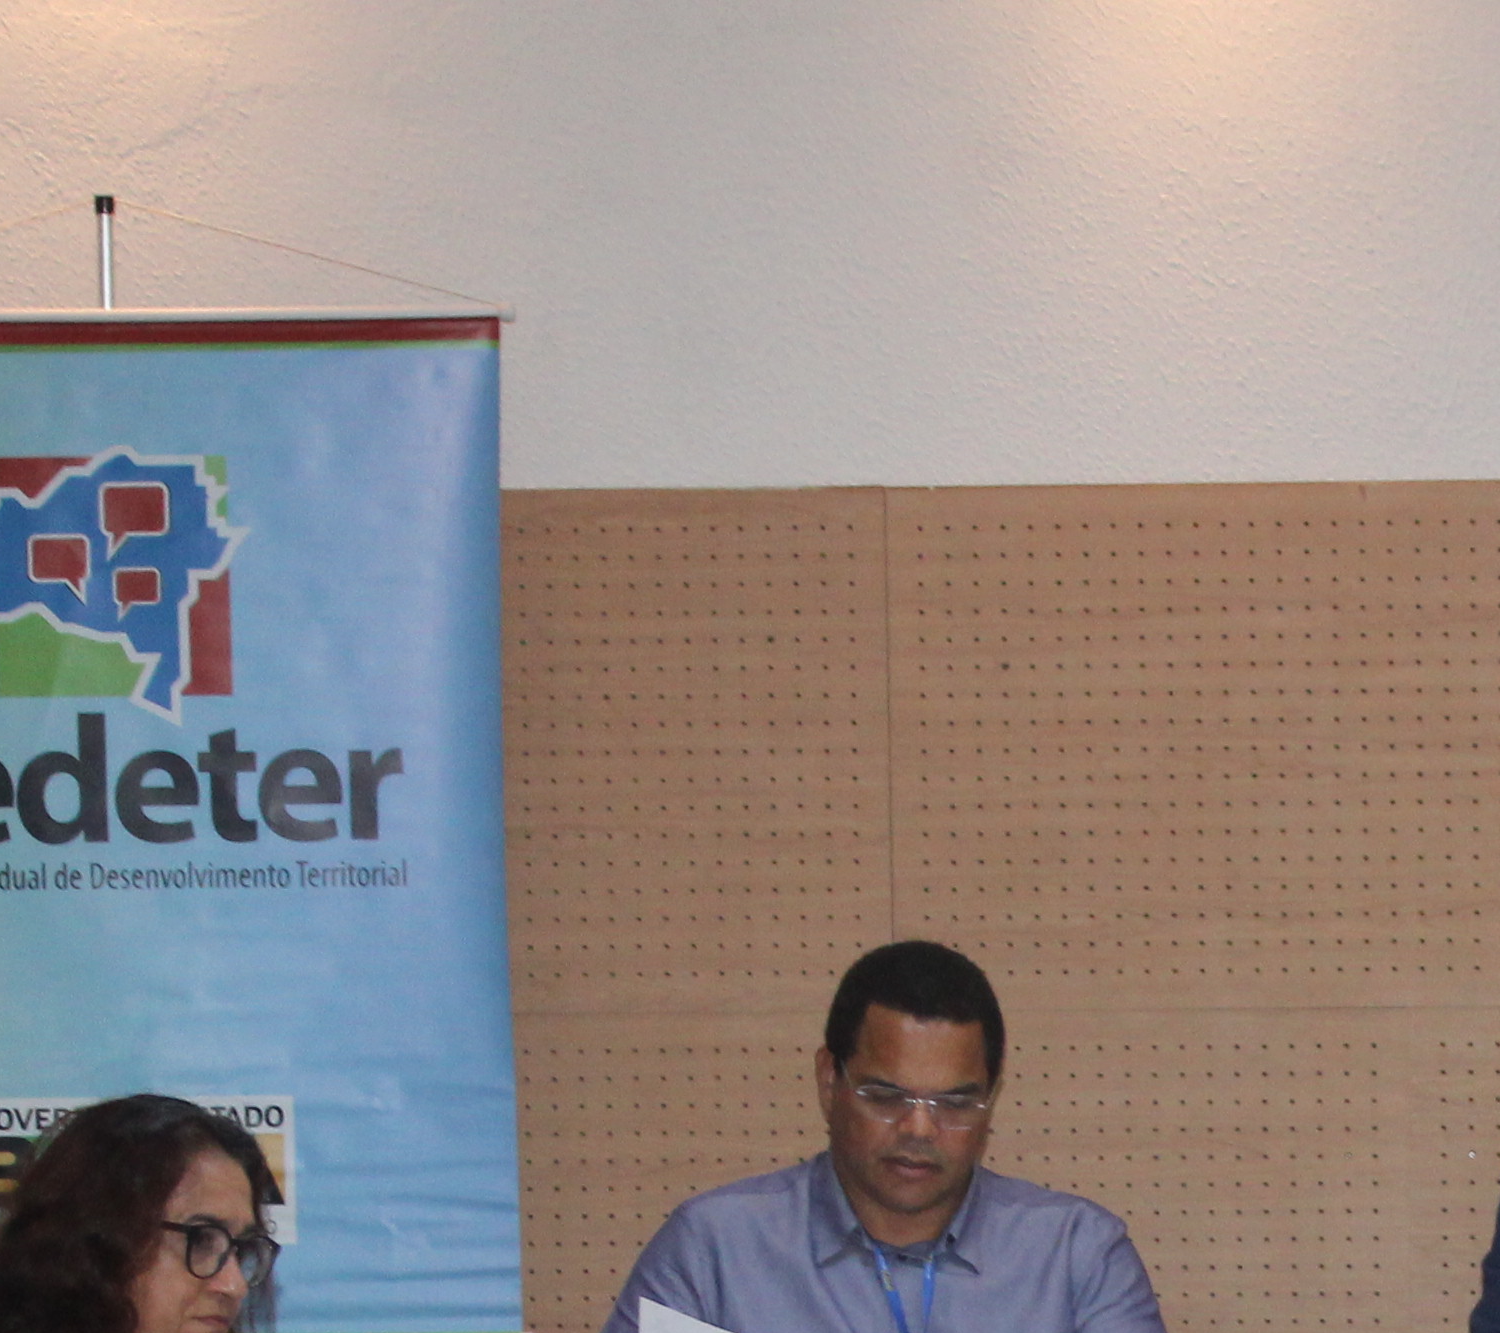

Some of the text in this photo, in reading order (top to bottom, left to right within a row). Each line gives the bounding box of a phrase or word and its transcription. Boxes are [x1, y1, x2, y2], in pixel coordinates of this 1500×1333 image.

[54, 863, 84, 889] de
[90, 862, 290, 890] Desenvolvimento
[298, 860, 408, 888] Territorial
